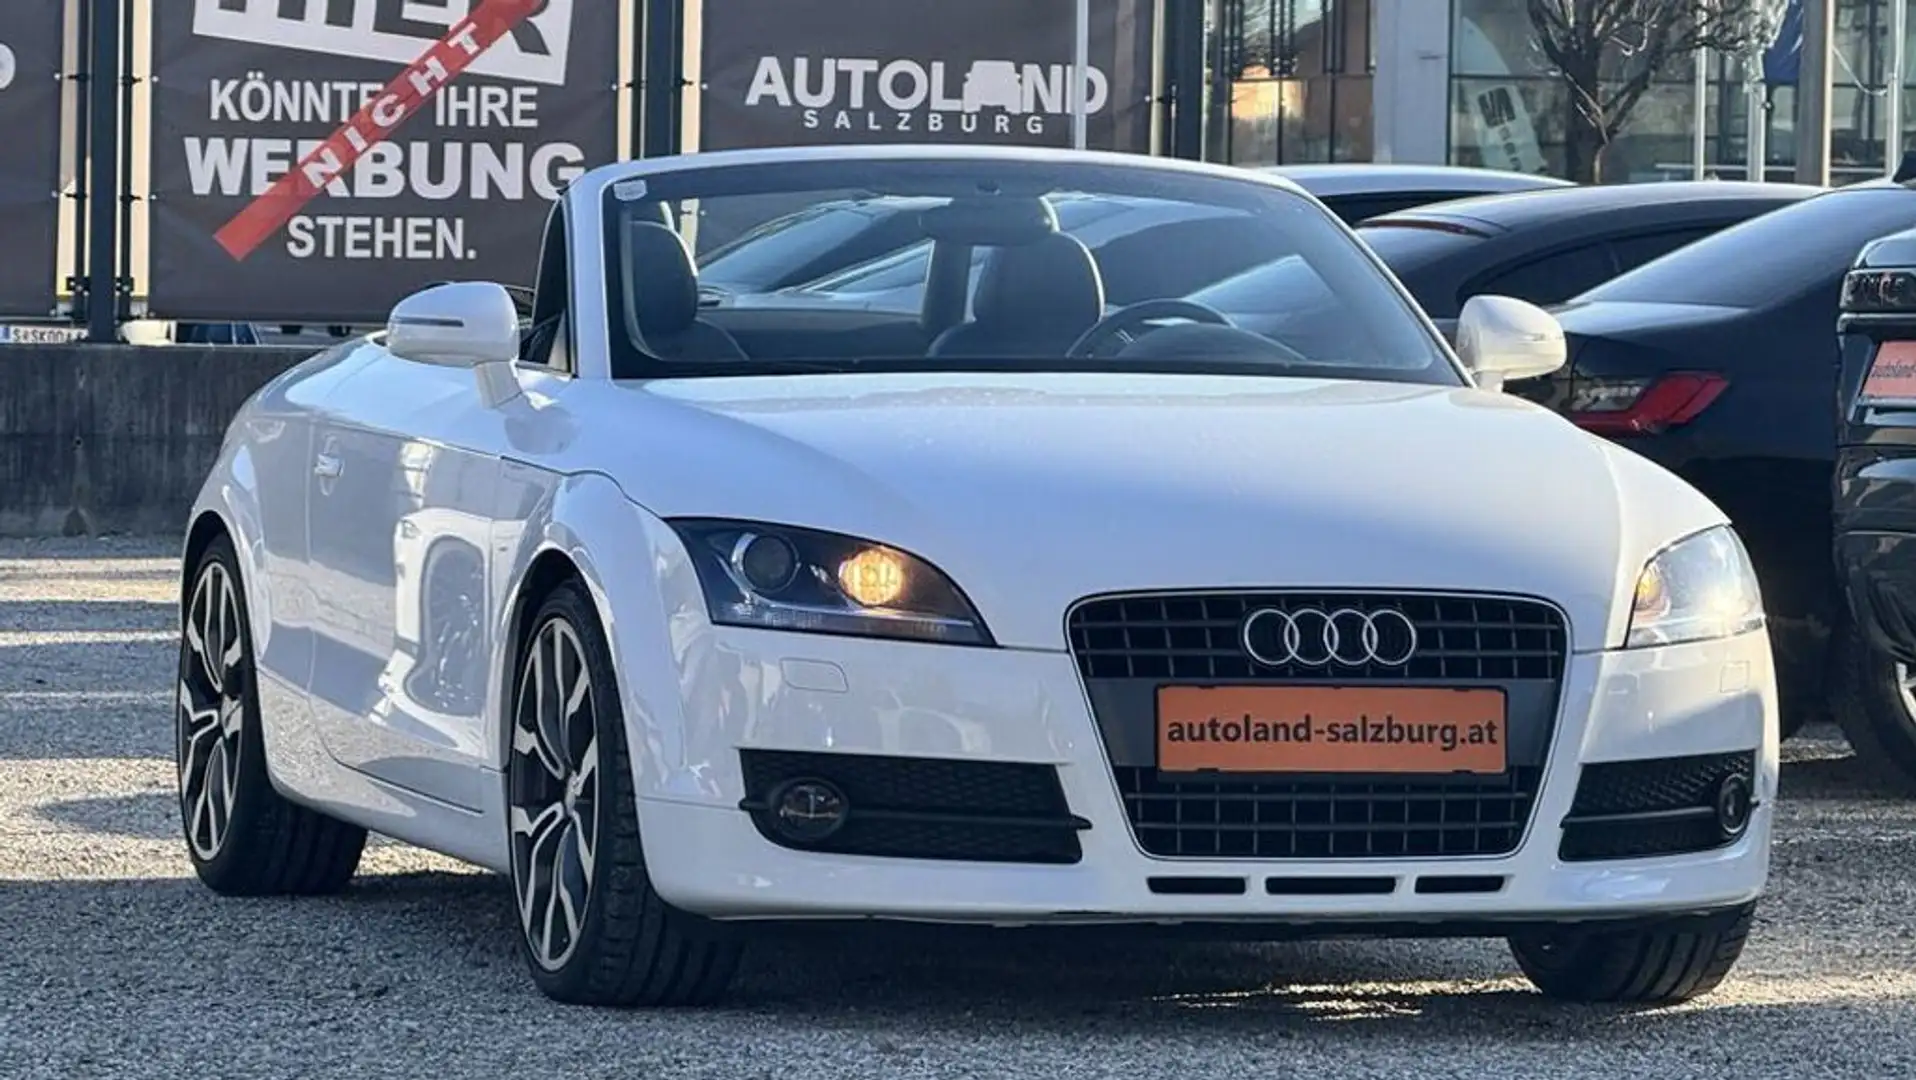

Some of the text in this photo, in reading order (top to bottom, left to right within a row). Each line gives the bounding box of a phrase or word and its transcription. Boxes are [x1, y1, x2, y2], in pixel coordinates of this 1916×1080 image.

[301, 22, 480, 188] NICHT
[436, 86, 538, 127] IHRE
[803, 110, 1044, 134] SALZBURG
[286, 215, 477, 260] STEHEN.
[1167, 714, 1498, 752] autoland-salzburg.at
